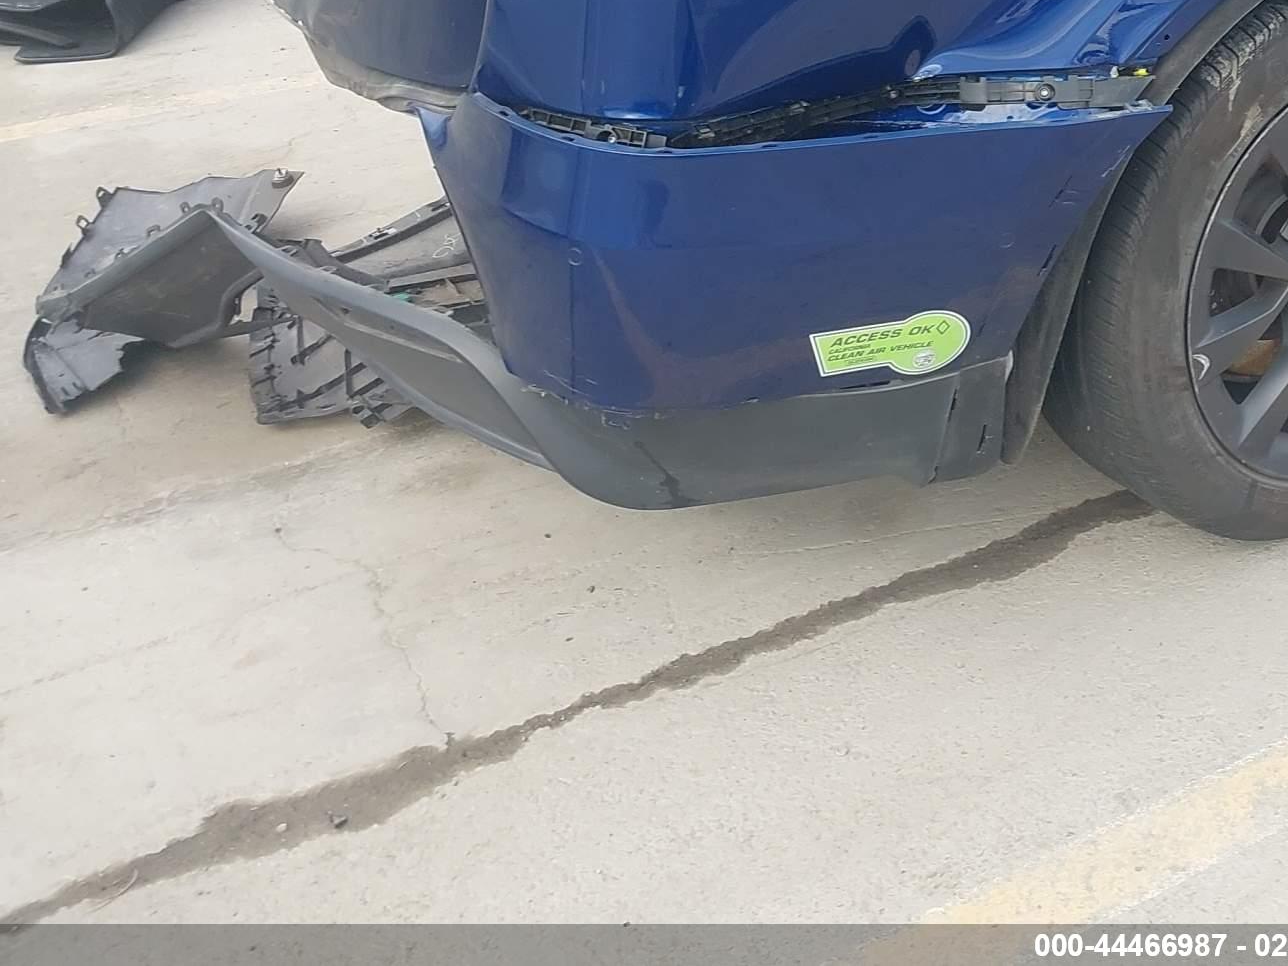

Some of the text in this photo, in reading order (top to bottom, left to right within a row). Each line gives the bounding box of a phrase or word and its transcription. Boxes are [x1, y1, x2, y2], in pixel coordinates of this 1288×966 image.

[830, 324, 936, 348] ACCESS OK
[827, 350, 863, 362] CLEAN
[867, 347, 887, 355] AIR
[890, 340, 934, 352] VEHICLE
